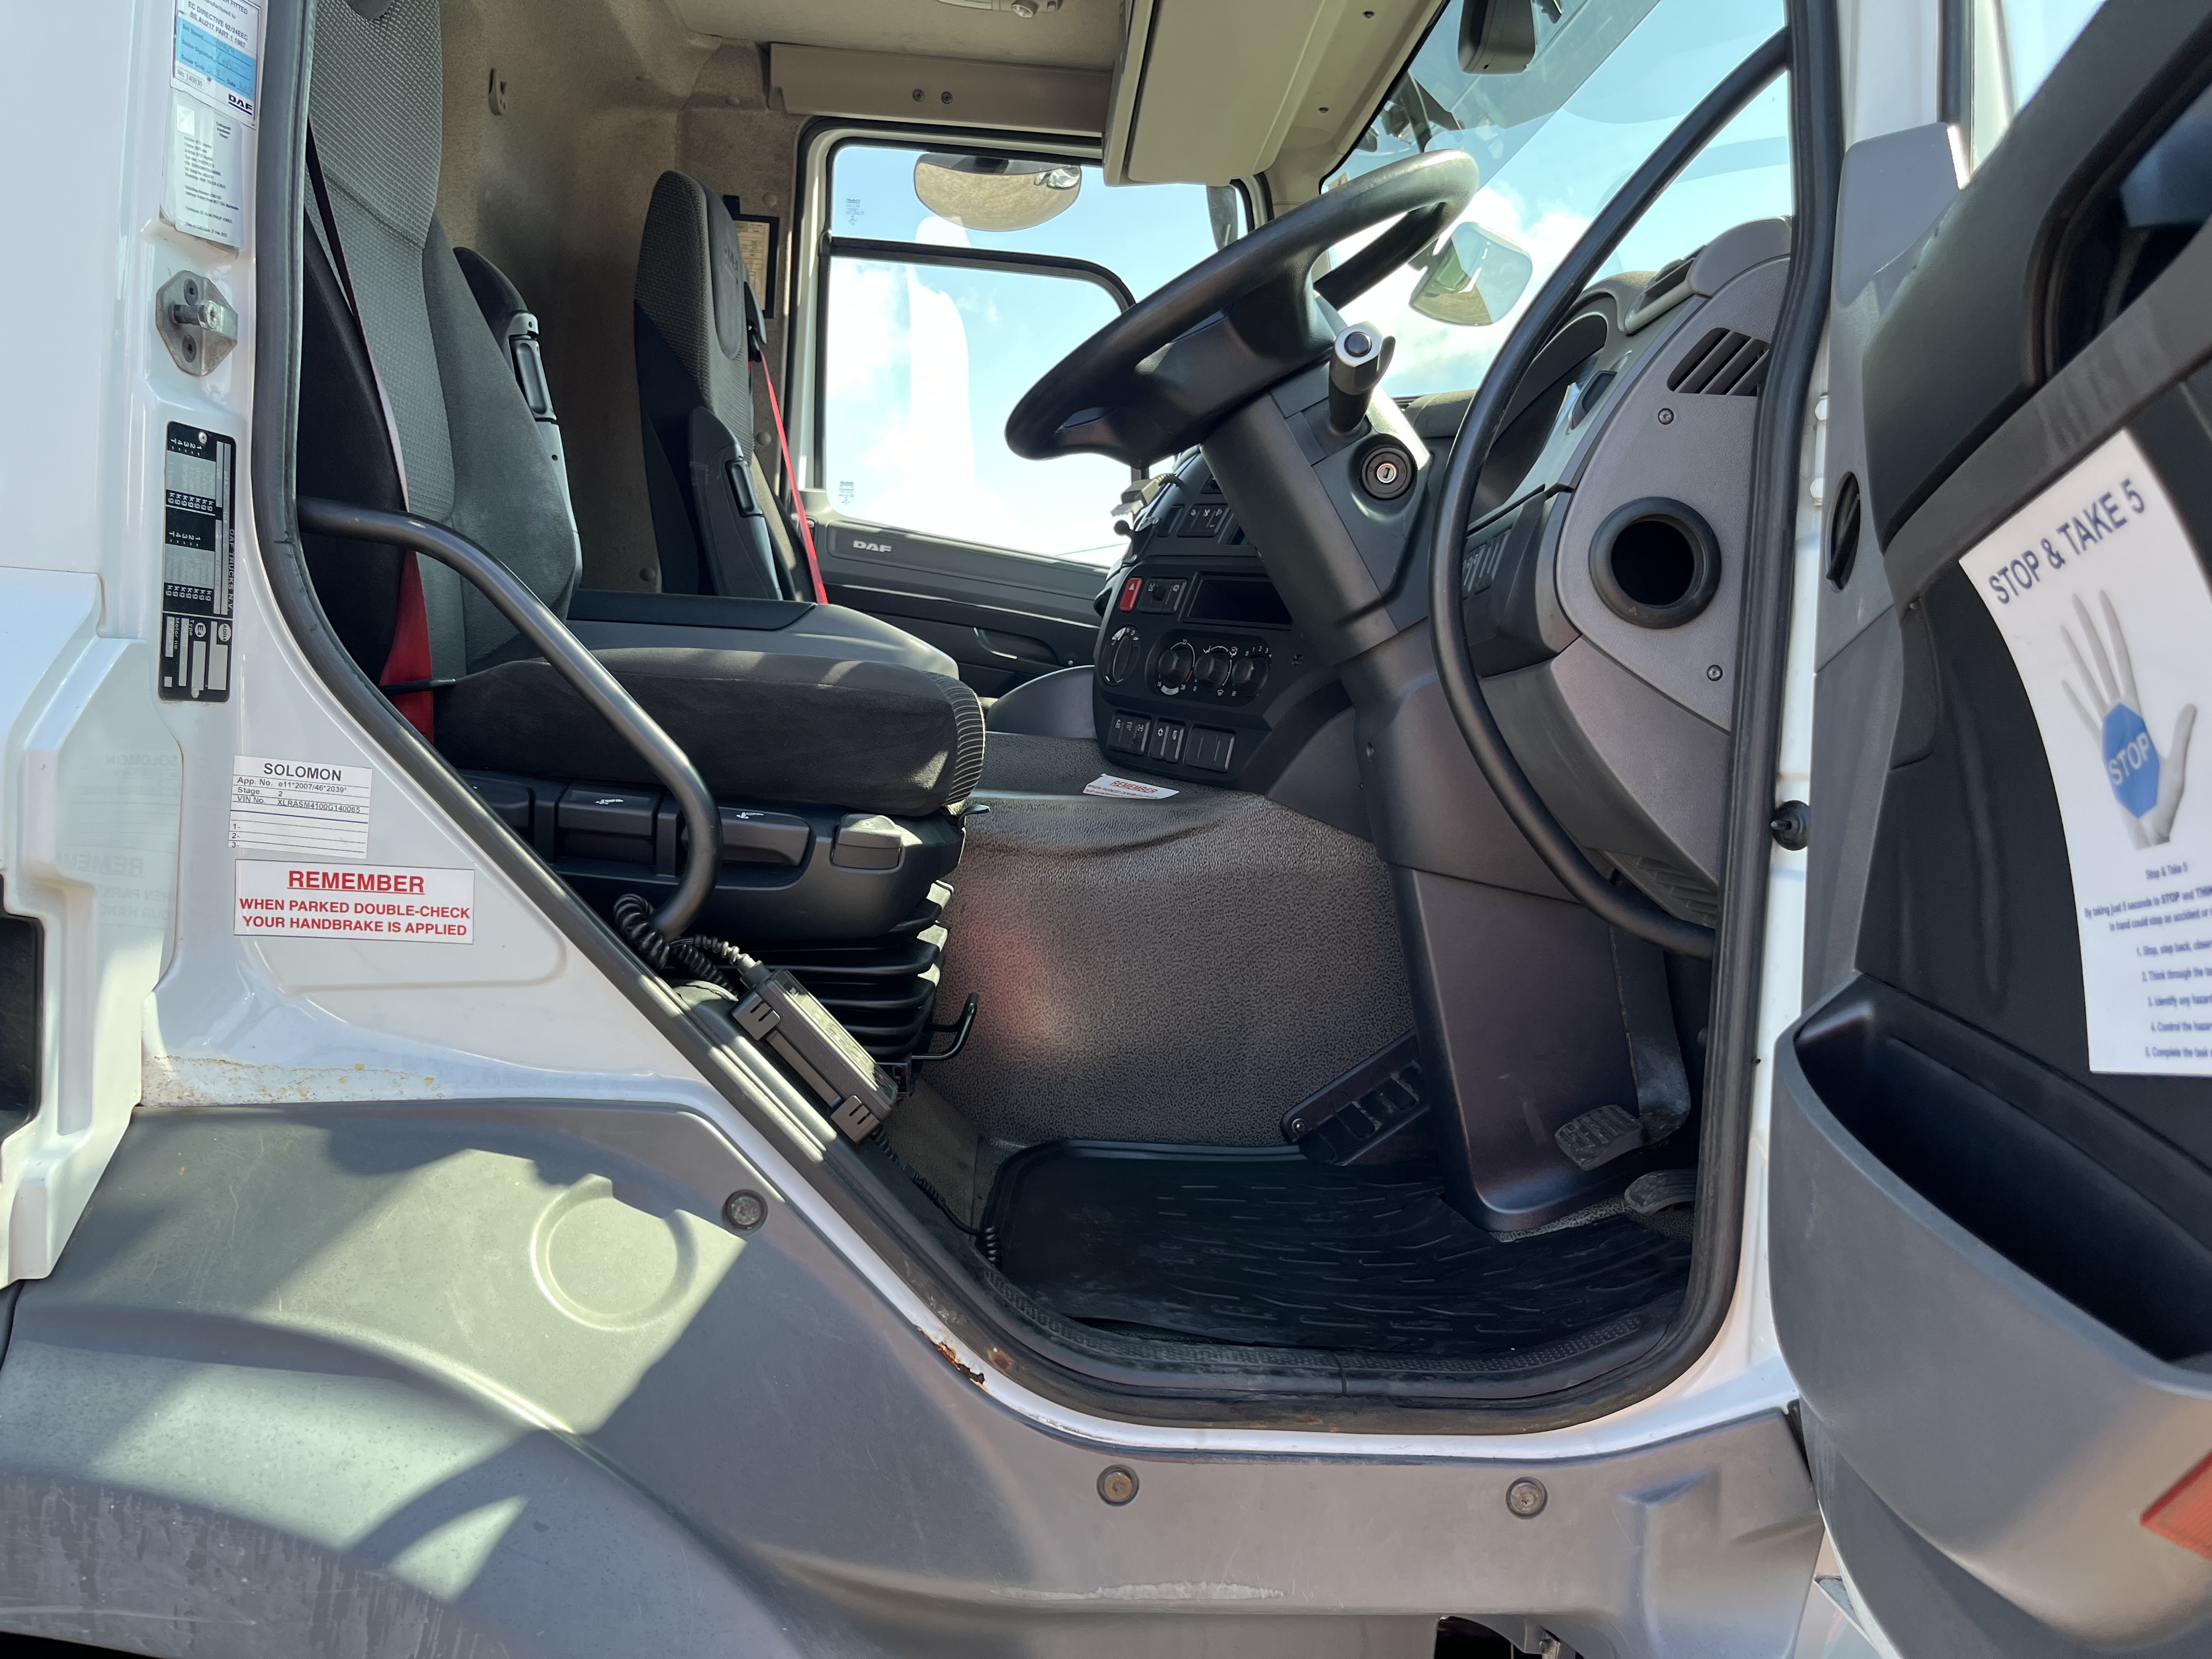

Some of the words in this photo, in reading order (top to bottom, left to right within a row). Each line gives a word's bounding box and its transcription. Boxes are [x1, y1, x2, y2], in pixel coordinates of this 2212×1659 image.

[230, 0, 247, 14] FITTED
[189, 1, 196, 10] EC
[197, 6, 224, 27] DIRECTIVE
[199, 15, 215, 30] AU217
[216, 27, 228, 39] PART
[228, 93, 253, 110] DAF
[168, 492, 174, 504] kg
[175, 494, 181, 505] kg
[182, 495, 188, 506] kg
[188, 496, 194, 507] kg
[194, 498, 201, 509] kg
[201, 499, 207, 510] kg
[207, 500, 213, 511] kg
[854, 540, 892, 552] DAF
[1988, 550, 2040, 605] STOP
[2041, 538, 2066, 569] &
[2056, 492, 2126, 555] TAKE
[2121, 478, 2145, 514] 5
[166, 585, 173, 596] kg
[173, 586, 179, 597] kg
[179, 587, 186, 598] kg
[186, 588, 193, 599] kg
[193, 589, 199, 600] kg
[199, 590, 206, 600] kg
[206, 591, 212, 601] kg
[2108, 732, 2149, 786] STOP
[263, 763, 341, 781] SOLOMON
[237, 777, 257, 786] App.
[1110, 780, 1158, 794] REMEMBER
[237, 787, 262, 795] Stage.
[2146, 869, 2159, 880] Stop
[2167, 864, 2181, 874] Take
[289, 871, 425, 893] REMEMBER
[240, 899, 285, 911] WHEN
[290, 901, 349, 913] PARKED
[354, 903, 471, 918] DOUBLE-CHECK
[2085, 908, 2091, 919] By
[2092, 906, 2109, 916] taking
[2110, 903, 2121, 916] just
[2128, 898, 2152, 910] seconds
[2162, 891, 2180, 904] STOP
[2182, 889, 2193, 900] and
[242, 916, 285, 928] YOUR
[290, 918, 383, 932] HANDBRAKE
[388, 922, 402, 933] IS
[405, 923, 467, 936] APPLIED
[2115, 919, 2130, 930] hand
[2132, 916, 2148, 928] could
[2149, 916, 2163, 927] stop
[2174, 910, 2200, 922] accident
[2160, 944, 2172, 956] step
[2148, 970, 2165, 980] Think
[2167, 968, 2191, 980] through
[2193, 967, 2203, 977] the
[2155, 995, 2177, 1008] Identify
[2157, 1022, 2180, 1031] Control
[2182, 1021, 2192, 1031] the
[2152, 1047, 2181, 1059] Complete
[2183, 1047, 2193, 1057] the
